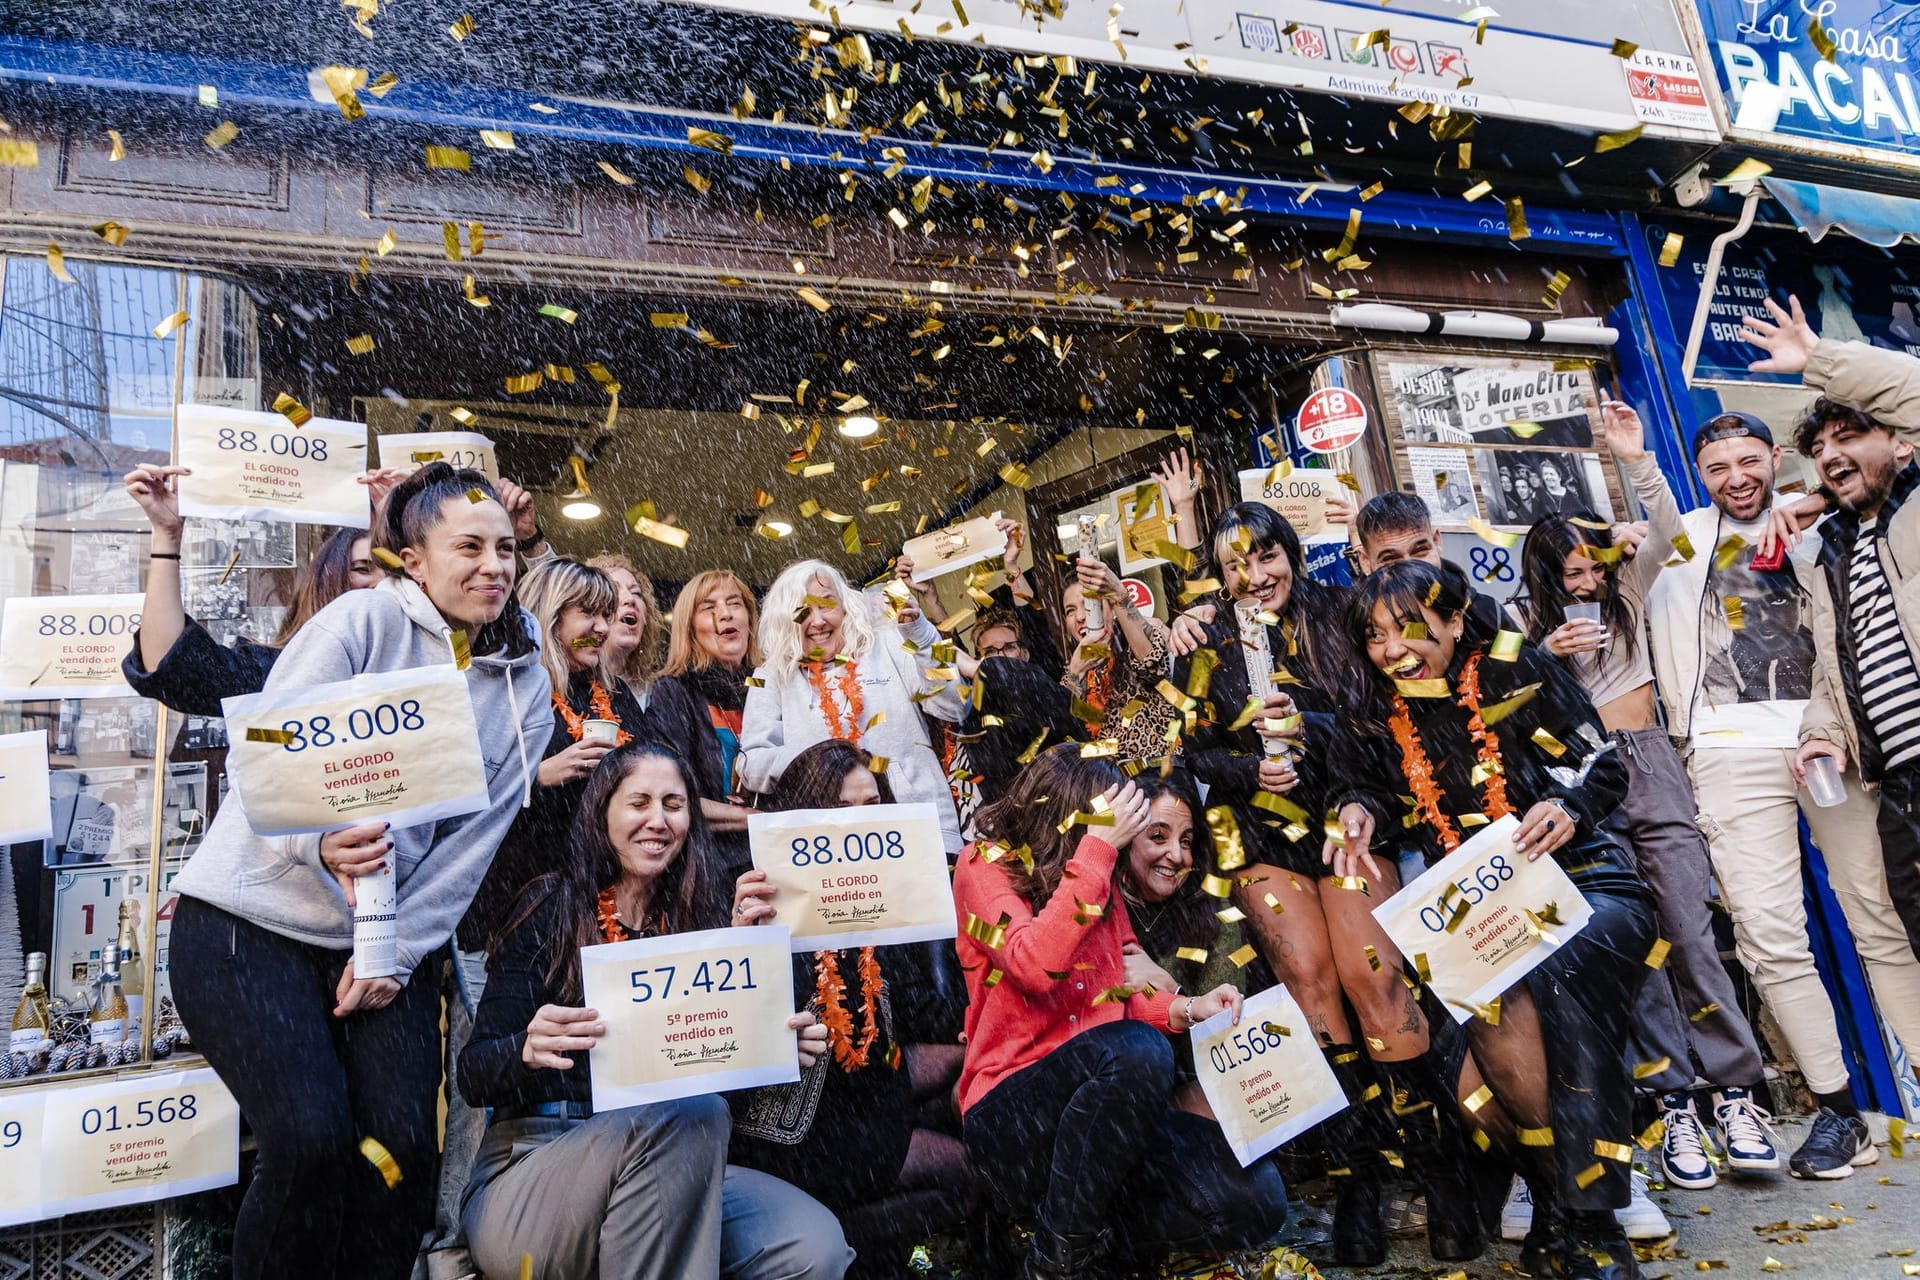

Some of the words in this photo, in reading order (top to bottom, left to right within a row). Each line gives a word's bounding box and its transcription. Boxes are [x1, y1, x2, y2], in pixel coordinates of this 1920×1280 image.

[1737, 0, 1798, 42] La
[1800, 0, 1907, 62] Casa
[1622, 53, 1696, 73] LARMA
[1327, 75, 1437, 104] Administración
[1461, 95, 1479, 108] 67
[1663, 82, 1700, 94] LASSER
[1640, 105, 1665, 118] 24h
[1693, 263, 1727, 277] ESA
[1732, 267, 1767, 280] CASA
[1699, 283, 1731, 297] LO
[1734, 286, 1770, 300] VENDE
[1309, 392, 1347, 417] +18
[1467, 394, 1586, 428] LOTERIA
[218, 428, 328, 462] 88.008
[243, 473, 285, 487] vendido
[288, 477, 301, 488] en
[244, 462, 257, 471] EL
[260, 463, 299, 477] GORDO
[1470, 547, 1515, 582] 88
[39, 613, 142, 636] 88.008
[60, 656, 101, 664] vendido
[62, 645, 73, 654] EL
[76, 645, 115, 654] GORDO
[282, 699, 425, 752] 88.008
[323, 762, 341, 775] EL
[343, 751, 394, 772] GORDO
[324, 771, 380, 791] vendido
[383, 767, 400, 779] en
[791, 830, 905, 867] 88.008
[821, 879, 834, 889] EL
[836, 874, 879, 887] GORDO
[821, 890, 866, 904] vendido
[869, 890, 882, 899] en
[1420, 855, 1513, 933] 01568
[1478, 904, 1508, 930] premio
[1472, 924, 1509, 952] vendido
[1507, 913, 1520, 926] en
[631, 957, 757, 1003] 57.421
[685, 1008, 729, 1026] premio
[665, 1027, 716, 1043] vendido
[719, 1025, 733, 1035] en
[1210, 1020, 1281, 1073] 01.568
[1248, 1068, 1272, 1089] premio
[1245, 1086, 1271, 1105] vendido
[1271, 1080, 1281, 1092] en
[81, 1094, 197, 1135] 01.568
[0, 1121, 22, 1148] 9
[125, 1136, 165, 1151] premio
[106, 1153, 151, 1166] vendido
[153, 1150, 167, 1159] en
